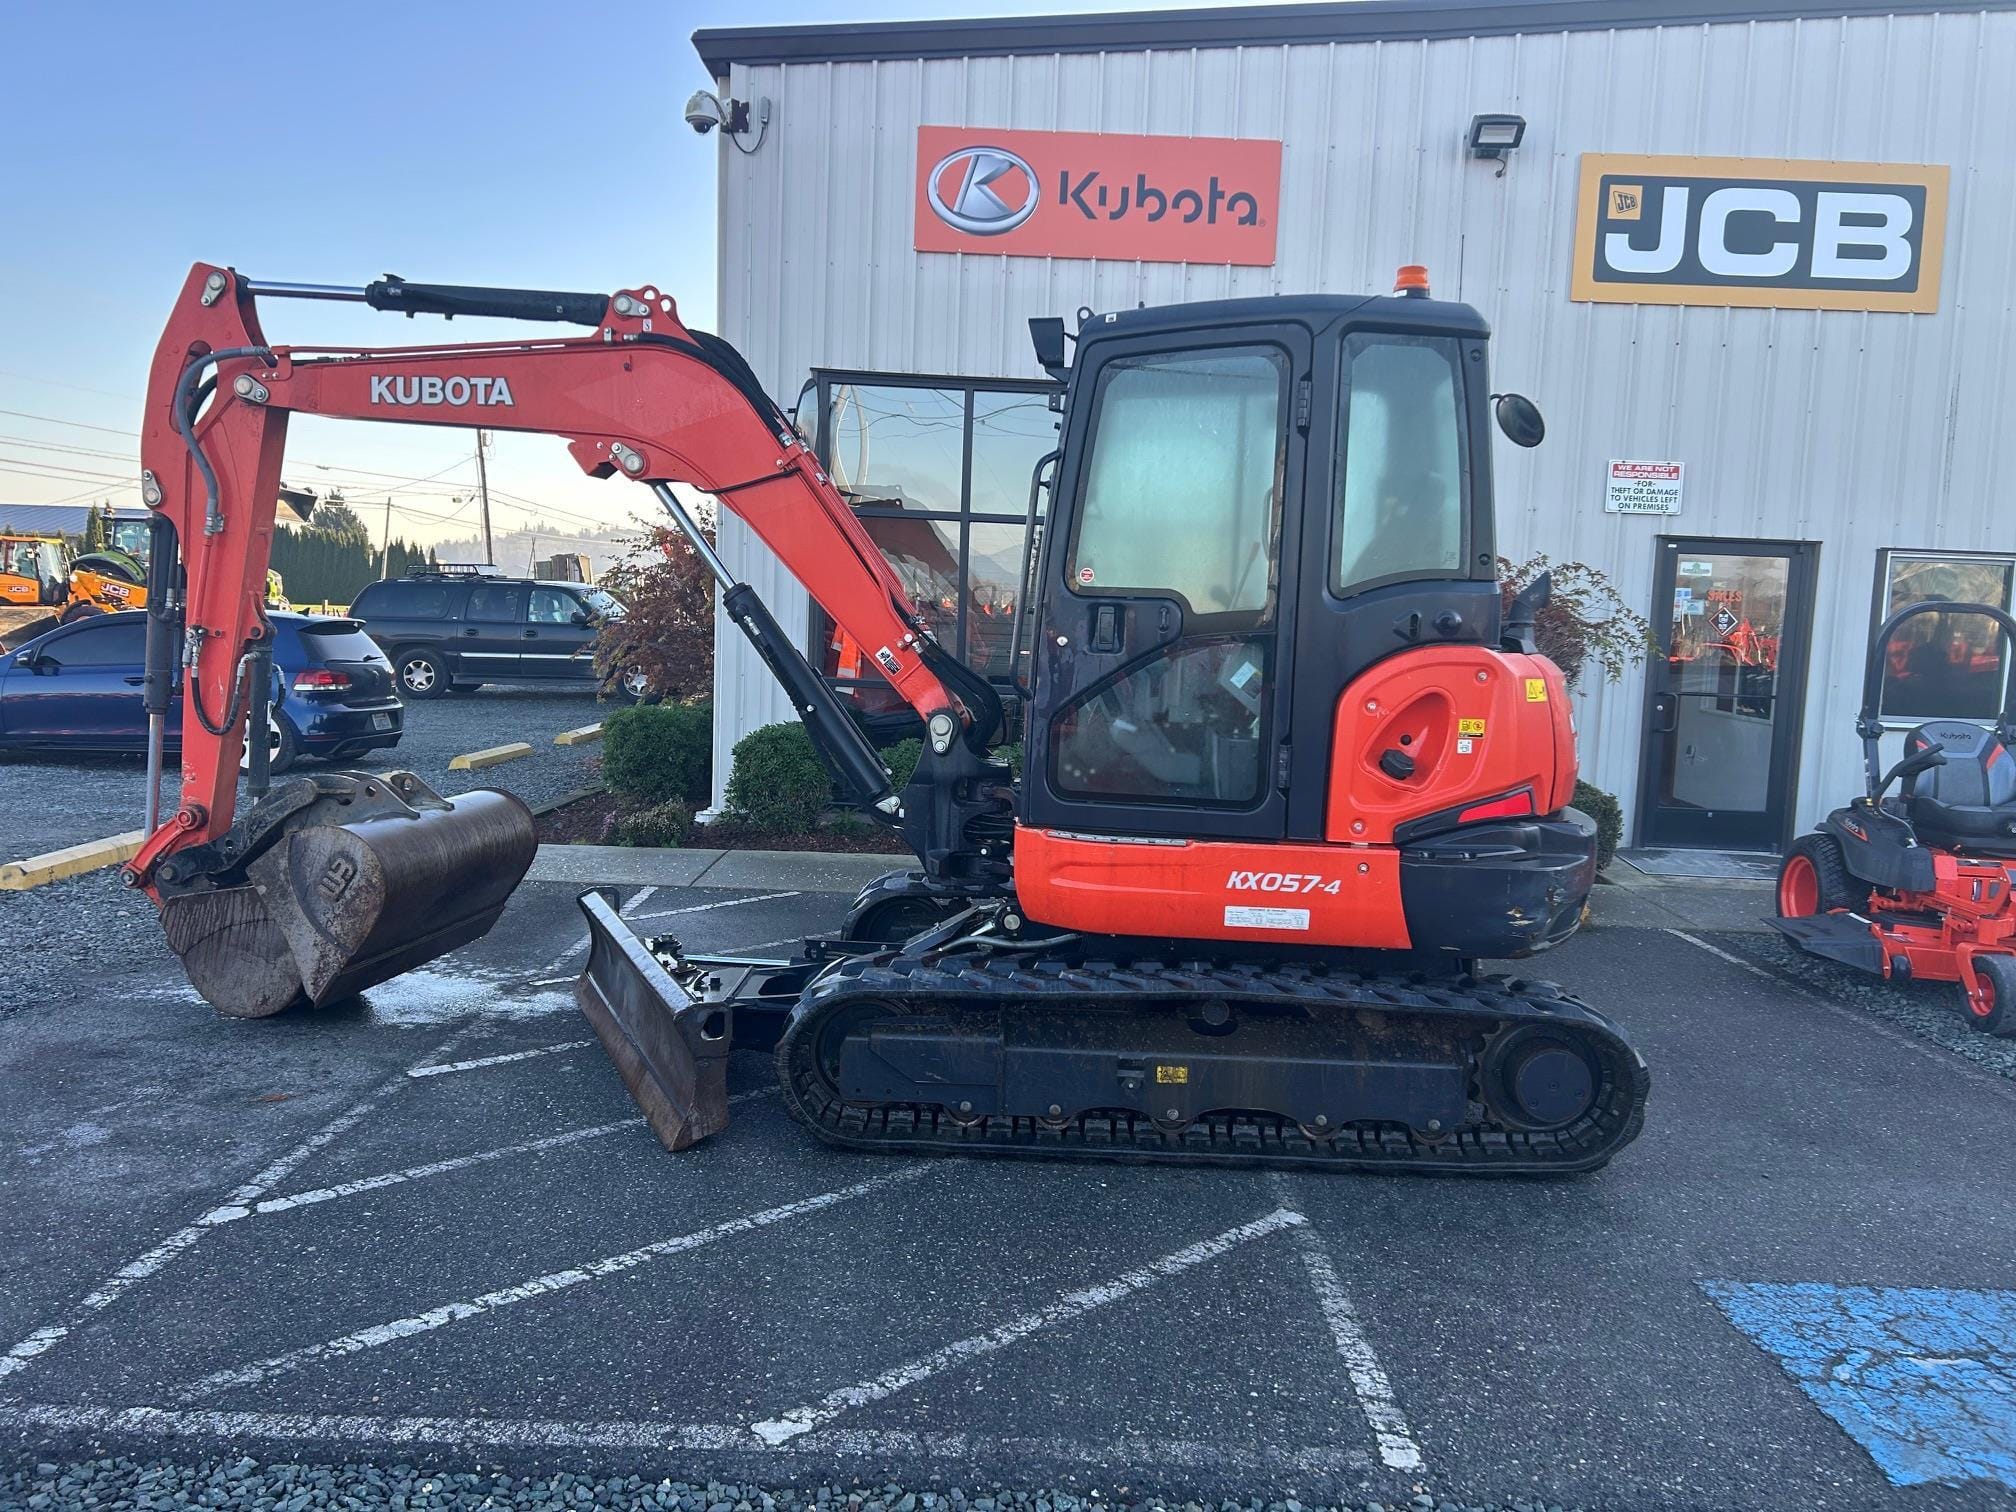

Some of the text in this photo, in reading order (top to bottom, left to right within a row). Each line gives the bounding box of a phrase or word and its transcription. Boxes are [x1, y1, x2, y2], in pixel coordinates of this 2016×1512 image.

[1058, 170, 1259, 226] Kubota
[1617, 193, 1637, 211] JCB
[1604, 186, 1914, 281] JCB
[370, 375, 515, 406] KUBOTA
[1613, 471, 1678, 480] RESPONSIBLE
[100, 582, 130, 597] JCB
[1225, 870, 1342, 895] KX057-4
